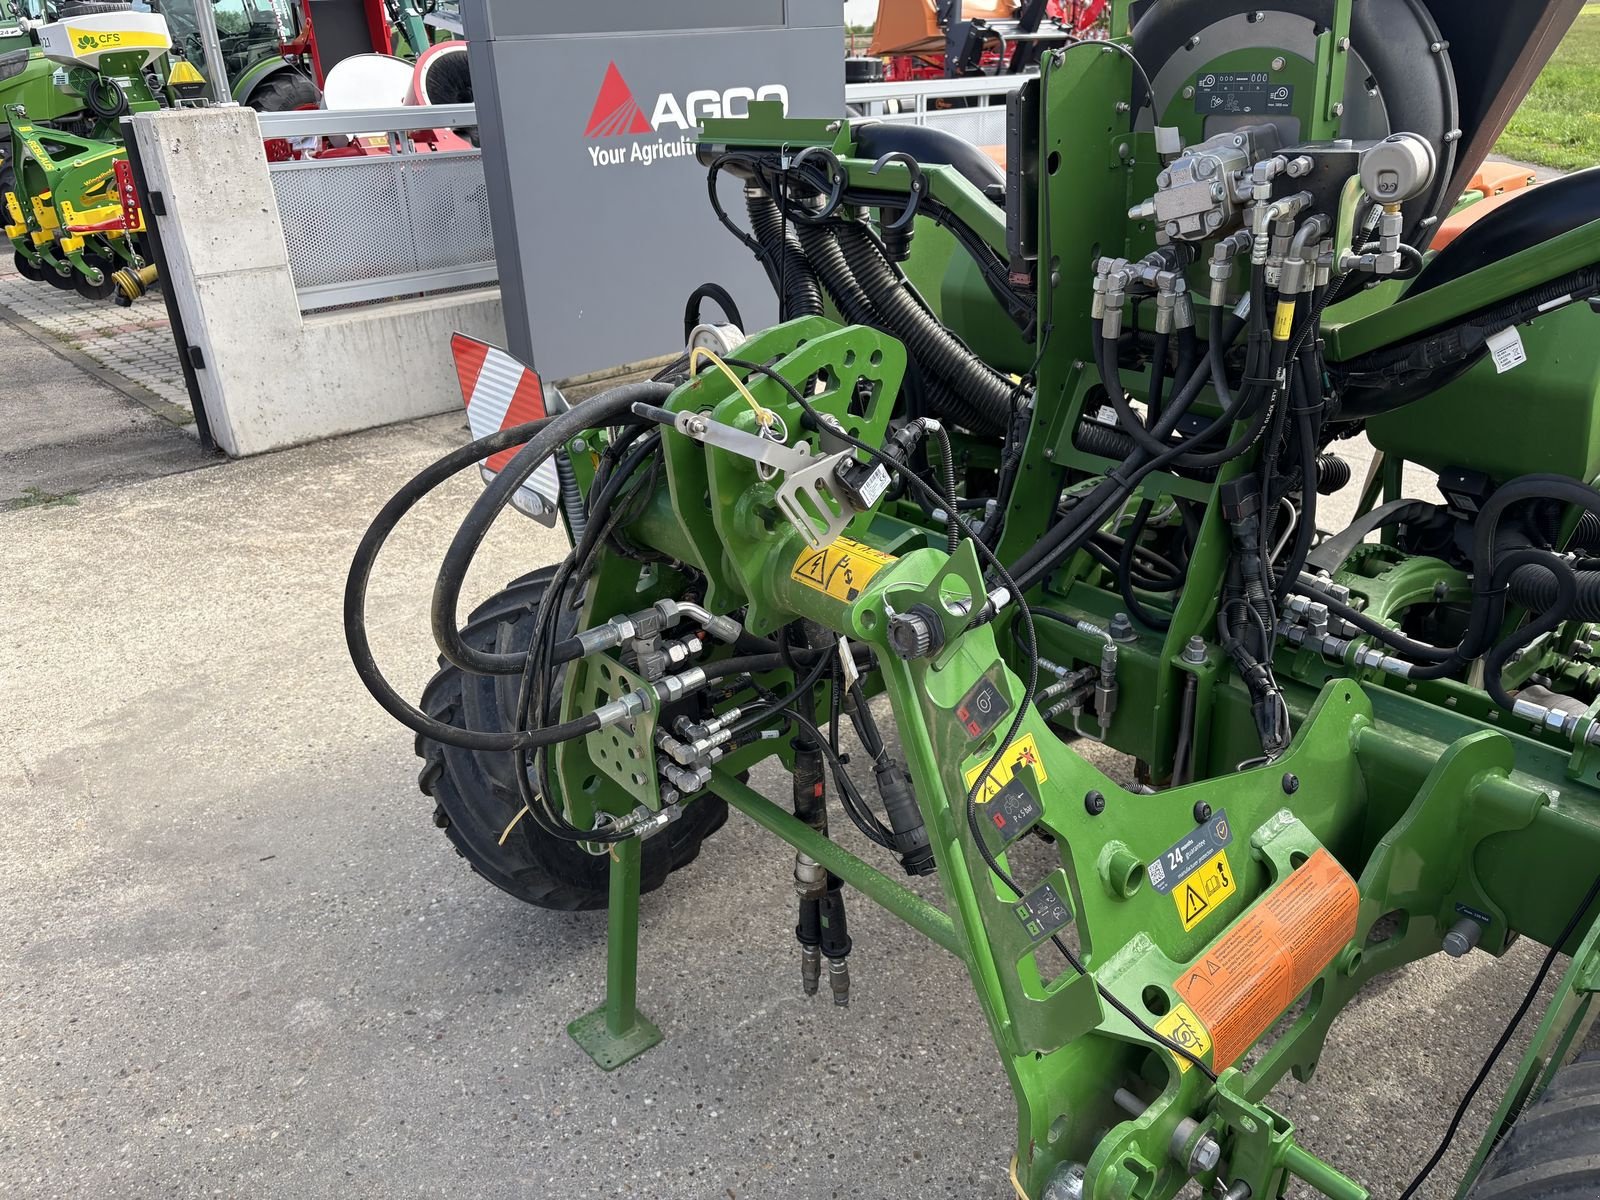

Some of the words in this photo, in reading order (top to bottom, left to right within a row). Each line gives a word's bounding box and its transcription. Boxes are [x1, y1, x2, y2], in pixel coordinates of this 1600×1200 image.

[98, 33, 121, 43] CFS
[28, 139, 55, 171] REBLAUS
[587, 142, 627, 167] Your
[1012, 815, 1018, 823] P
[1022, 804, 1033, 815] bar
[1167, 847, 1184, 871] 24
[1184, 839, 1207, 860] guarantee
